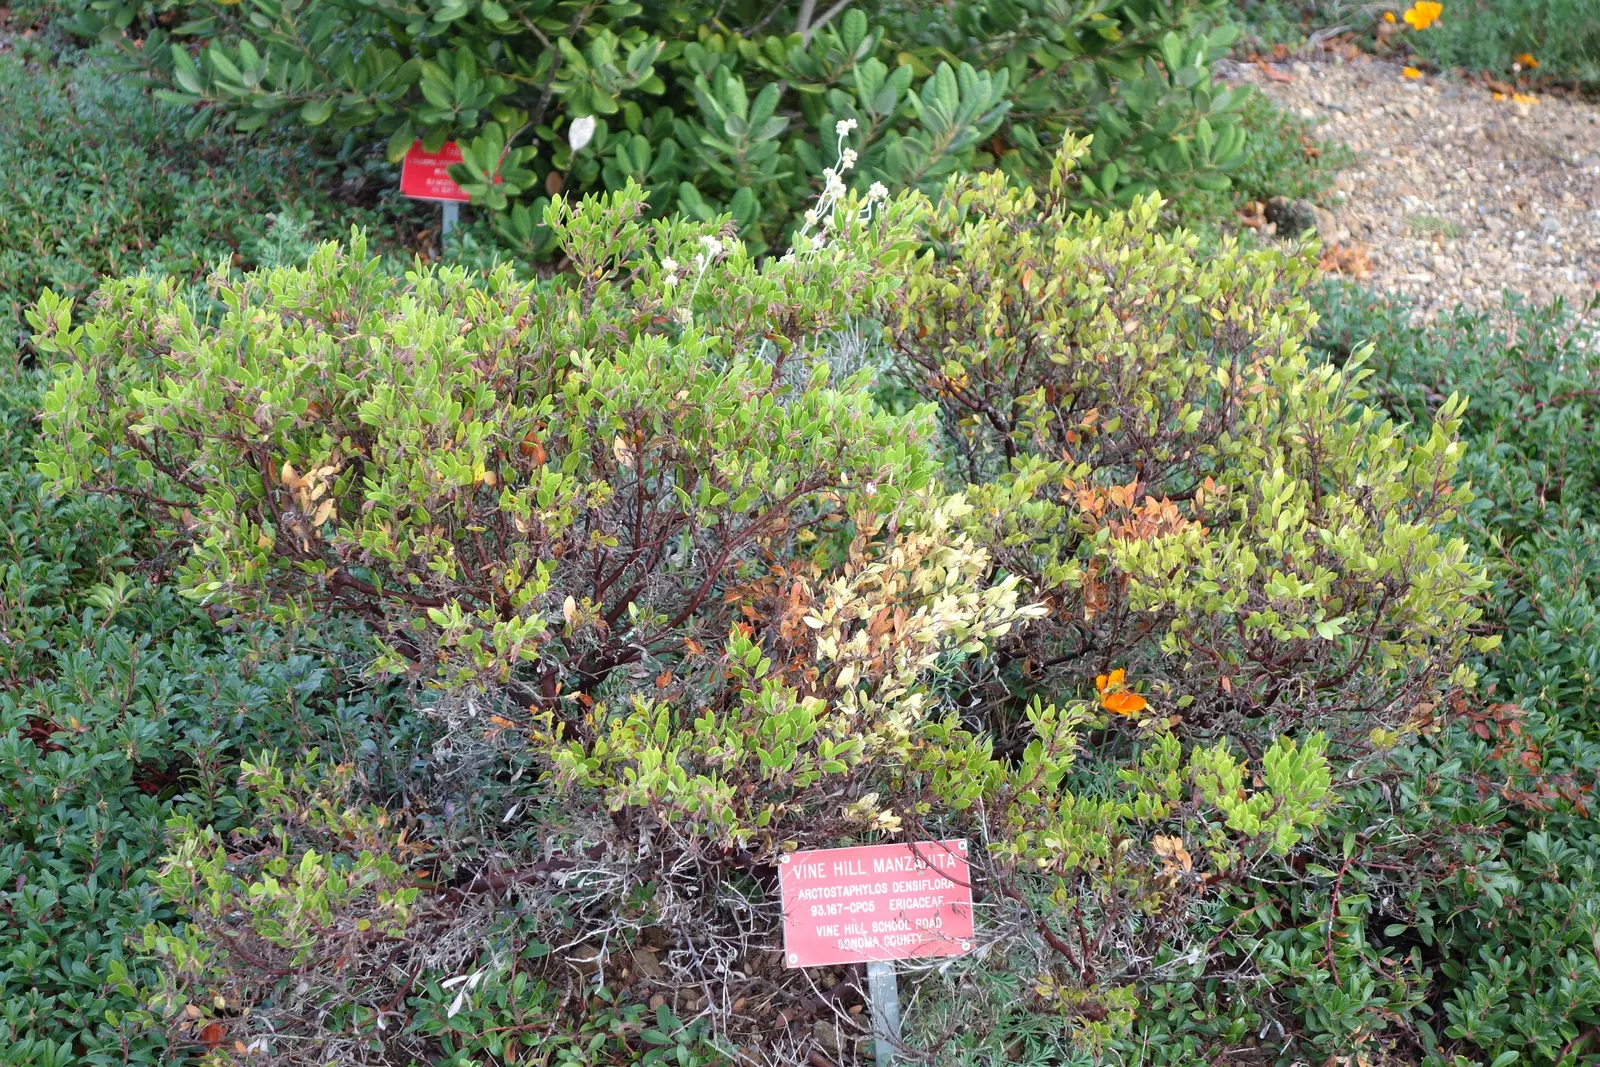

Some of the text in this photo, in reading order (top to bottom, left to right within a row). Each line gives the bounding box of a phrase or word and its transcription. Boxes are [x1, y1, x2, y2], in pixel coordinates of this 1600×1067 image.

[793, 863, 826, 879] VINE
[834, 860, 867, 877] HILL
[798, 878, 955, 900] ARCTOSTAPHYLOS DENSIFLORA
[816, 917, 942, 936] VINE HILL SCHOOL ROAD
[838, 933, 922, 950] SONOMA COUNTY
